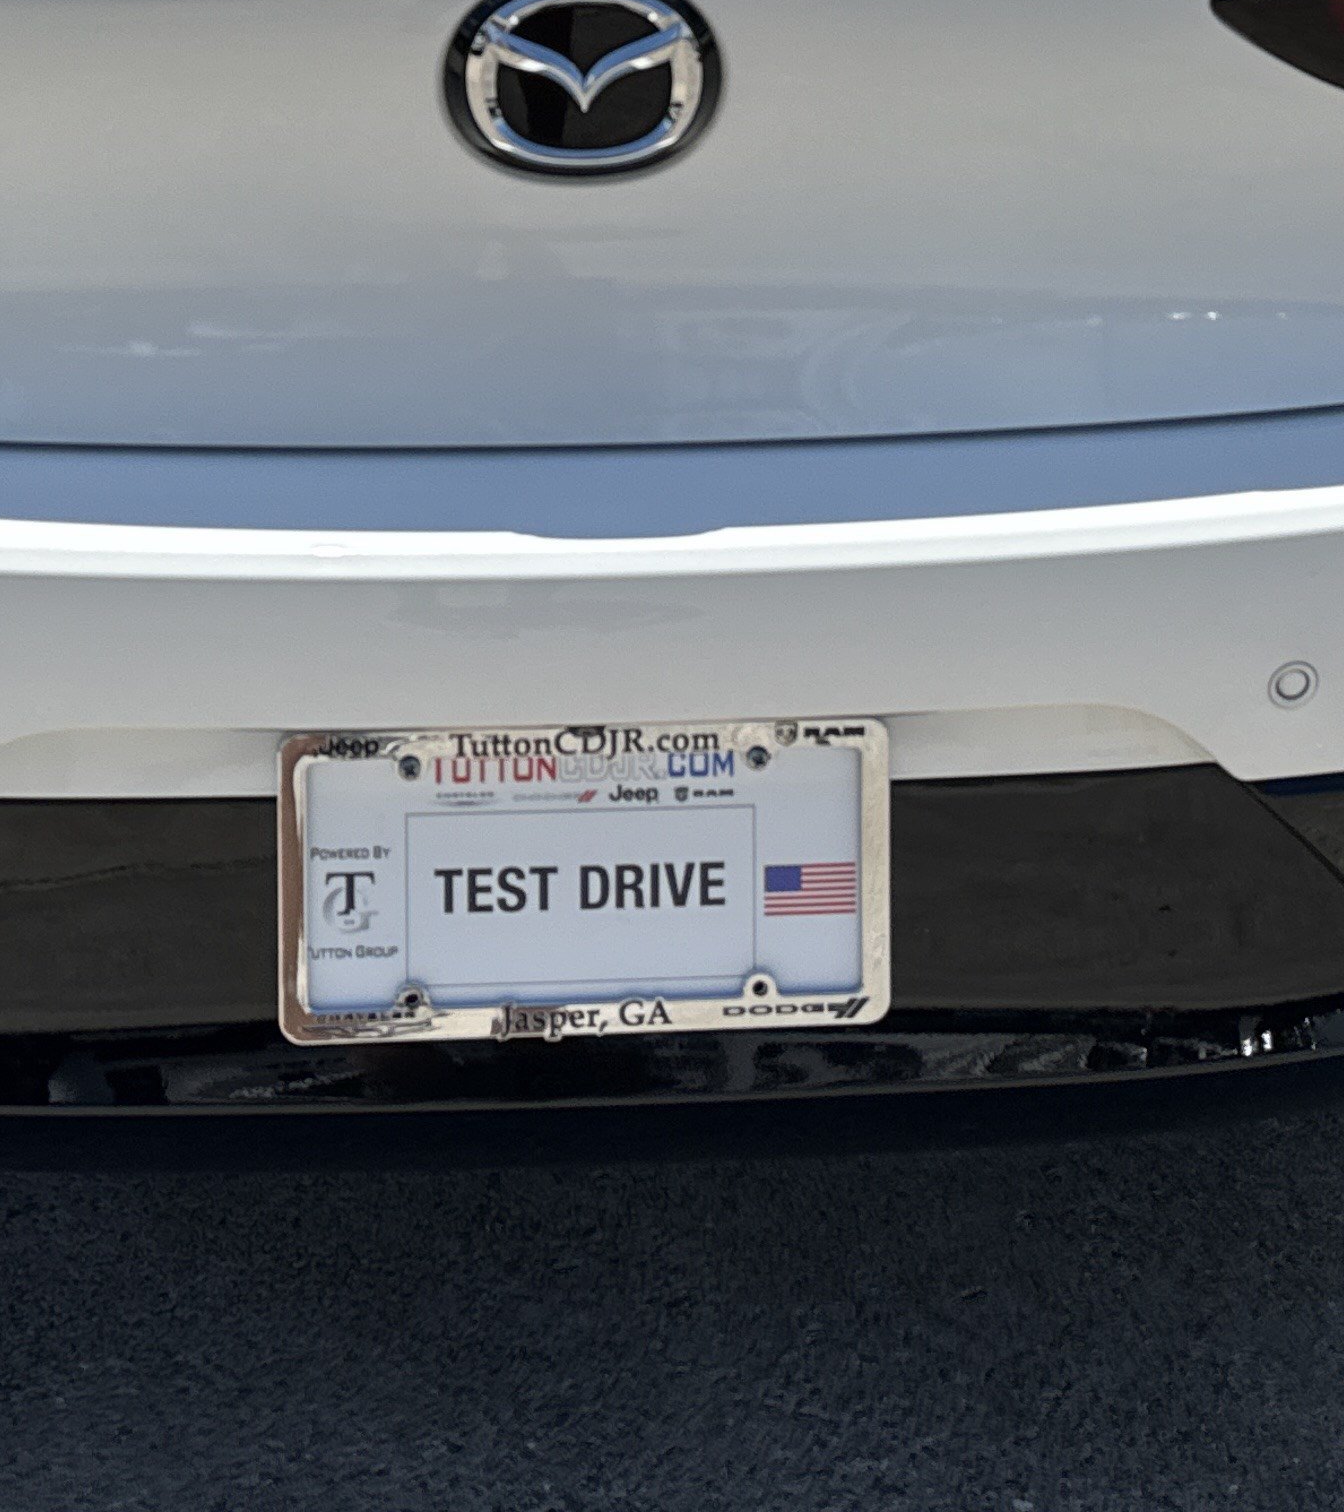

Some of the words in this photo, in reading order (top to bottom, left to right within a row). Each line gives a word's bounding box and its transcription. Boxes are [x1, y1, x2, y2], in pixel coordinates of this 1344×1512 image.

[316, 737, 380, 760] Jeep
[453, 726, 721, 760] TuttonCDJR.com
[608, 784, 659, 804] Jeep
[434, 865, 558, 914] TEST
[580, 862, 726, 911] DRIVE
[498, 1001, 609, 1037] Jasper,
[619, 999, 673, 1026] GA
